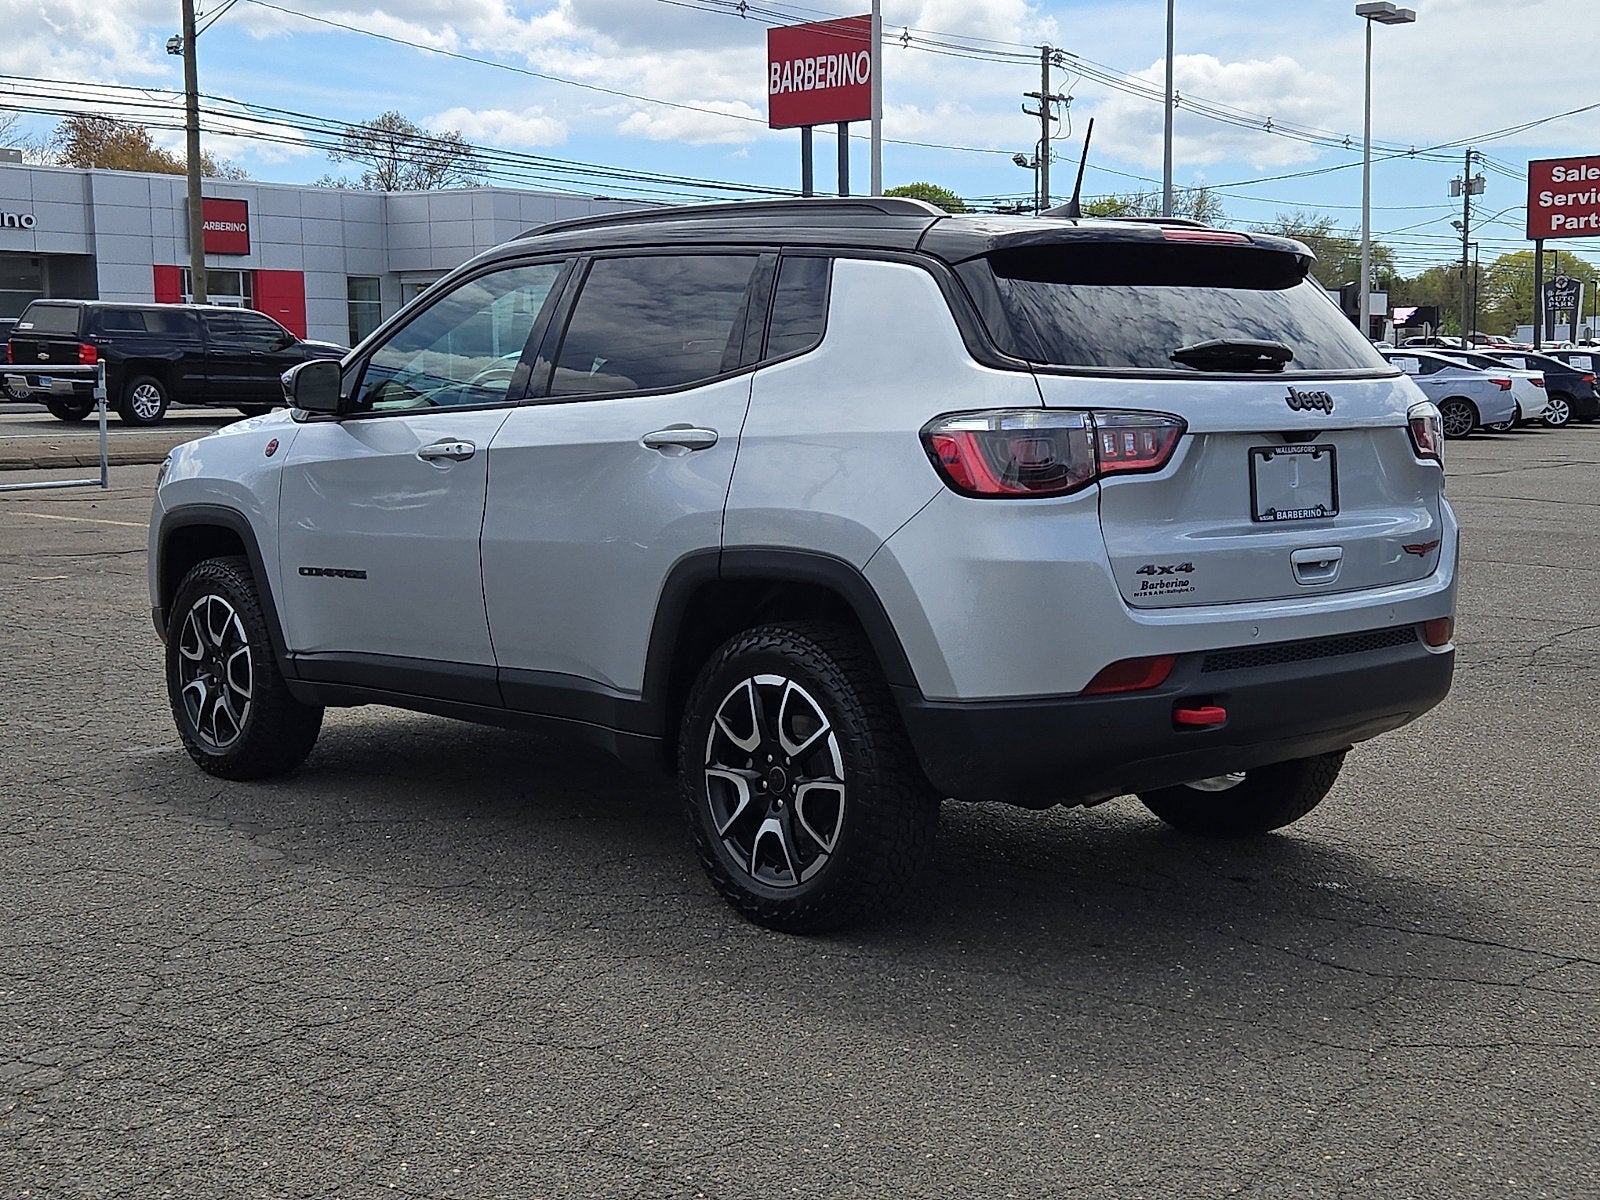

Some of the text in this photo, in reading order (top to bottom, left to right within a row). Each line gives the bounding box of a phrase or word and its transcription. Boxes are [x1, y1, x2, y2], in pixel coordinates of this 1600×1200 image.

[769, 50, 870, 95] BARBERINO
[1538, 187, 1600, 208] Servi
[202, 221, 247, 232] ARBERINO
[1551, 212, 1600, 231] Part
[1284, 386, 1334, 415] Jeep
[1276, 509, 1322, 519] BARBERINO
[1135, 562, 1195, 575] 4x4
[1140, 578, 1190, 591] Barberino
